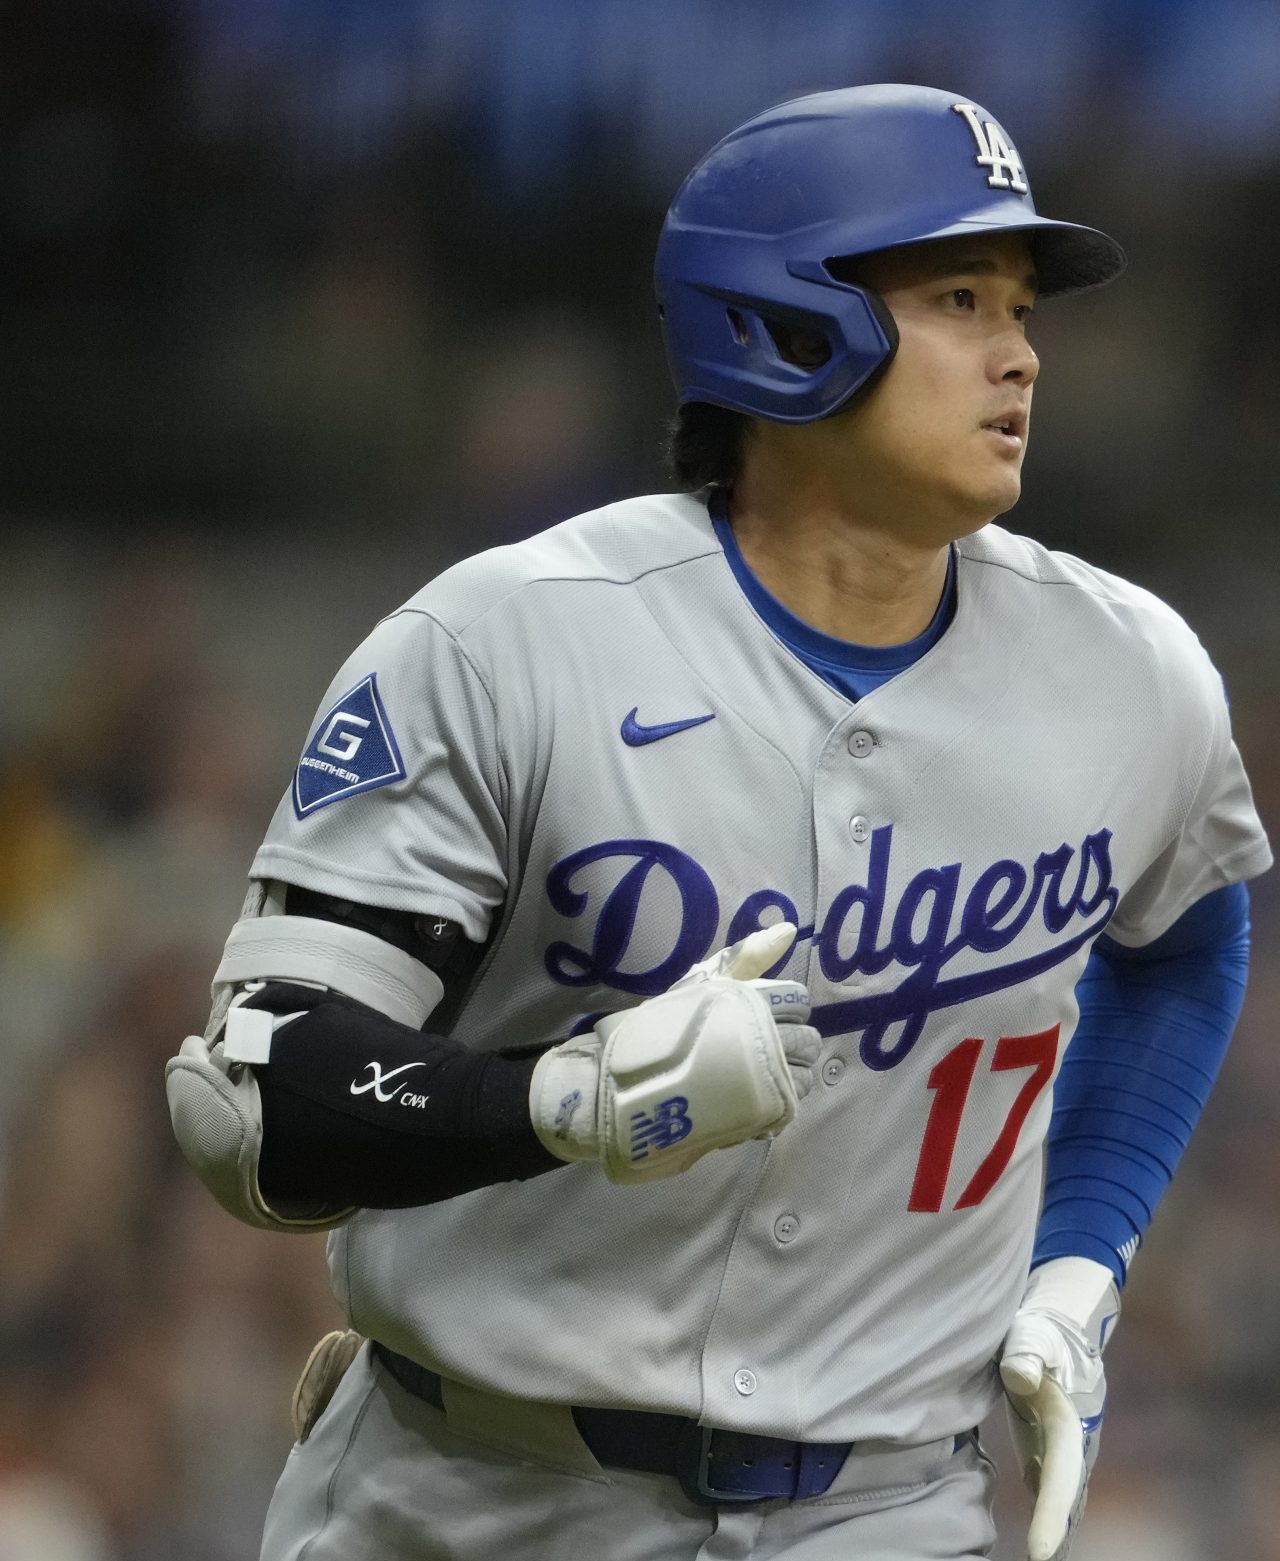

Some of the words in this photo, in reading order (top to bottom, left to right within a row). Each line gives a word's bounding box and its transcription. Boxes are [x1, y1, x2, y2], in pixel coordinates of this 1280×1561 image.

[953, 103, 1028, 194] LA
[317, 711, 371, 761] G
[544, 824, 1118, 1071] Dodgers
[907, 1023, 1061, 1213] 17
